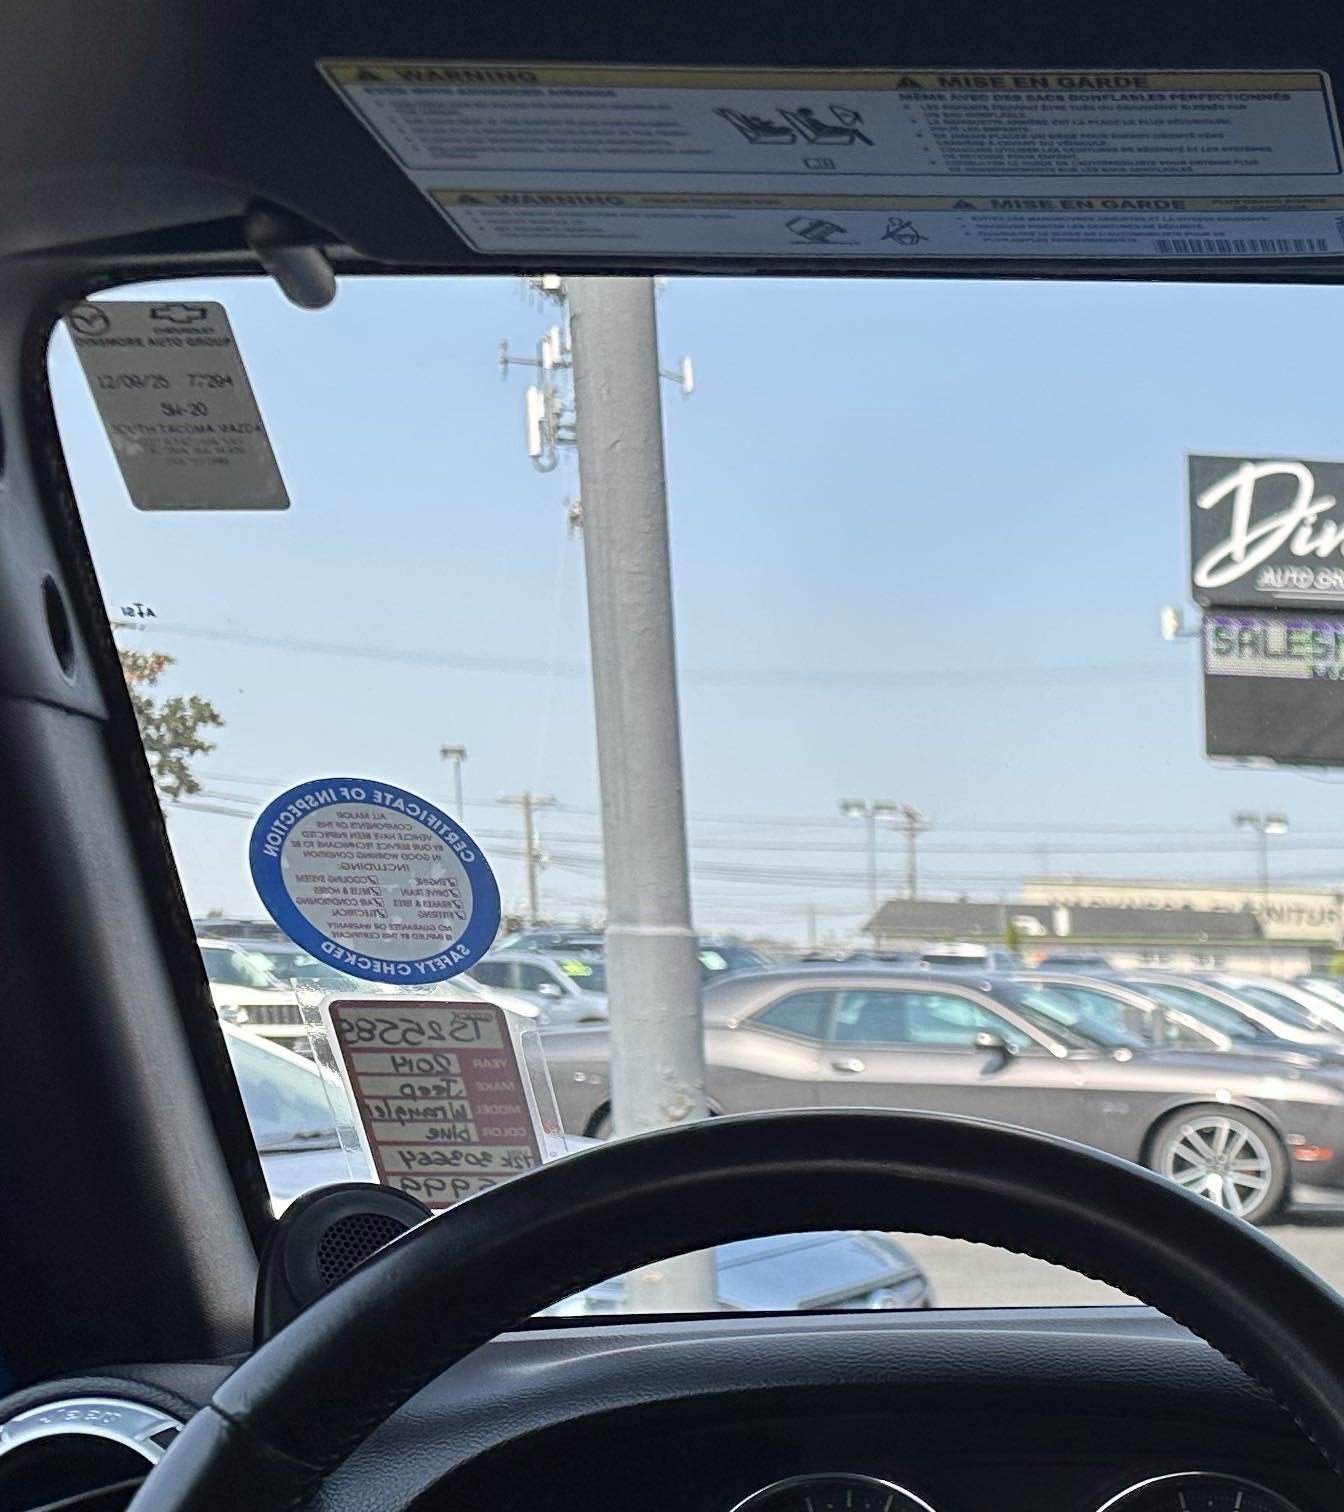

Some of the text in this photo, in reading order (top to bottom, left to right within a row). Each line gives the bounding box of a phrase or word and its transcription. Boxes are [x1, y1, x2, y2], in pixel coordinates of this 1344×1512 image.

[396, 69, 539, 82] WARNING
[938, 75, 1149, 90] MISE EN GARDE
[494, 194, 624, 206] WARNING
[990, 199, 1186, 211] MISE EN GARDE
[1256, 565, 1312, 589] AUTO
